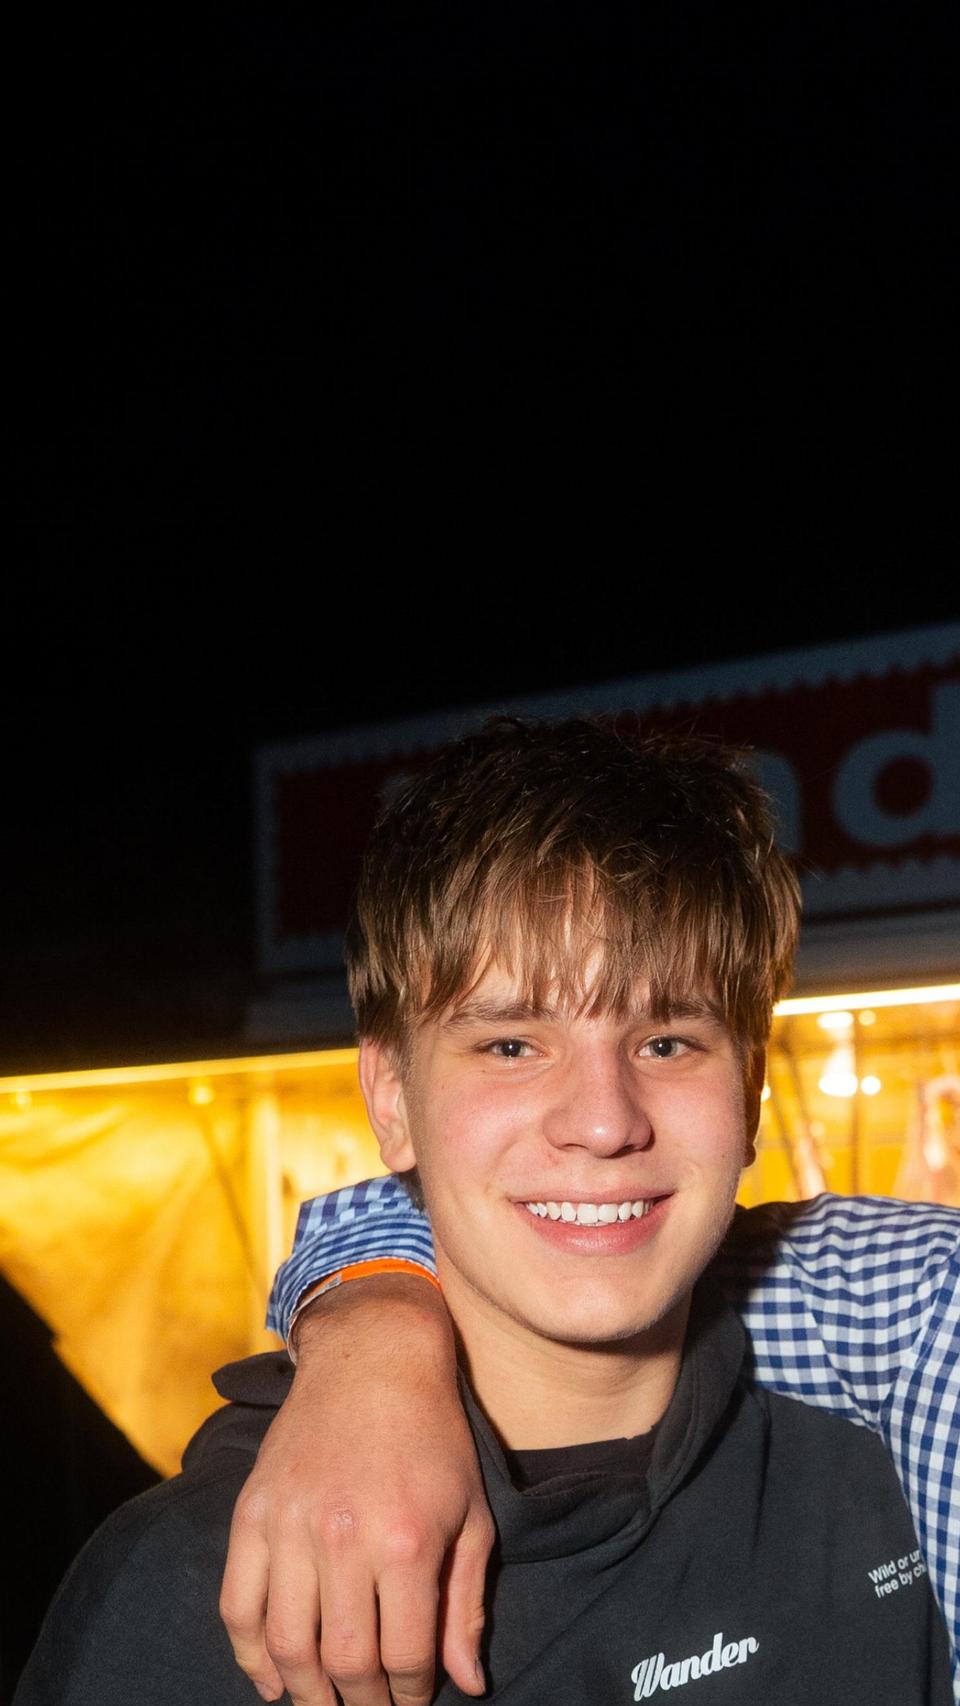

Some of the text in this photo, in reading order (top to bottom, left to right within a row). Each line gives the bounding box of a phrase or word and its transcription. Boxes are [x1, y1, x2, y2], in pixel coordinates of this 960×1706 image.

[867, 1560, 898, 1584] Wild
[897, 1556, 909, 1570] or
[874, 1578, 899, 1599] free
[898, 1570, 913, 1585] by
[630, 1631, 760, 1702] Wander
